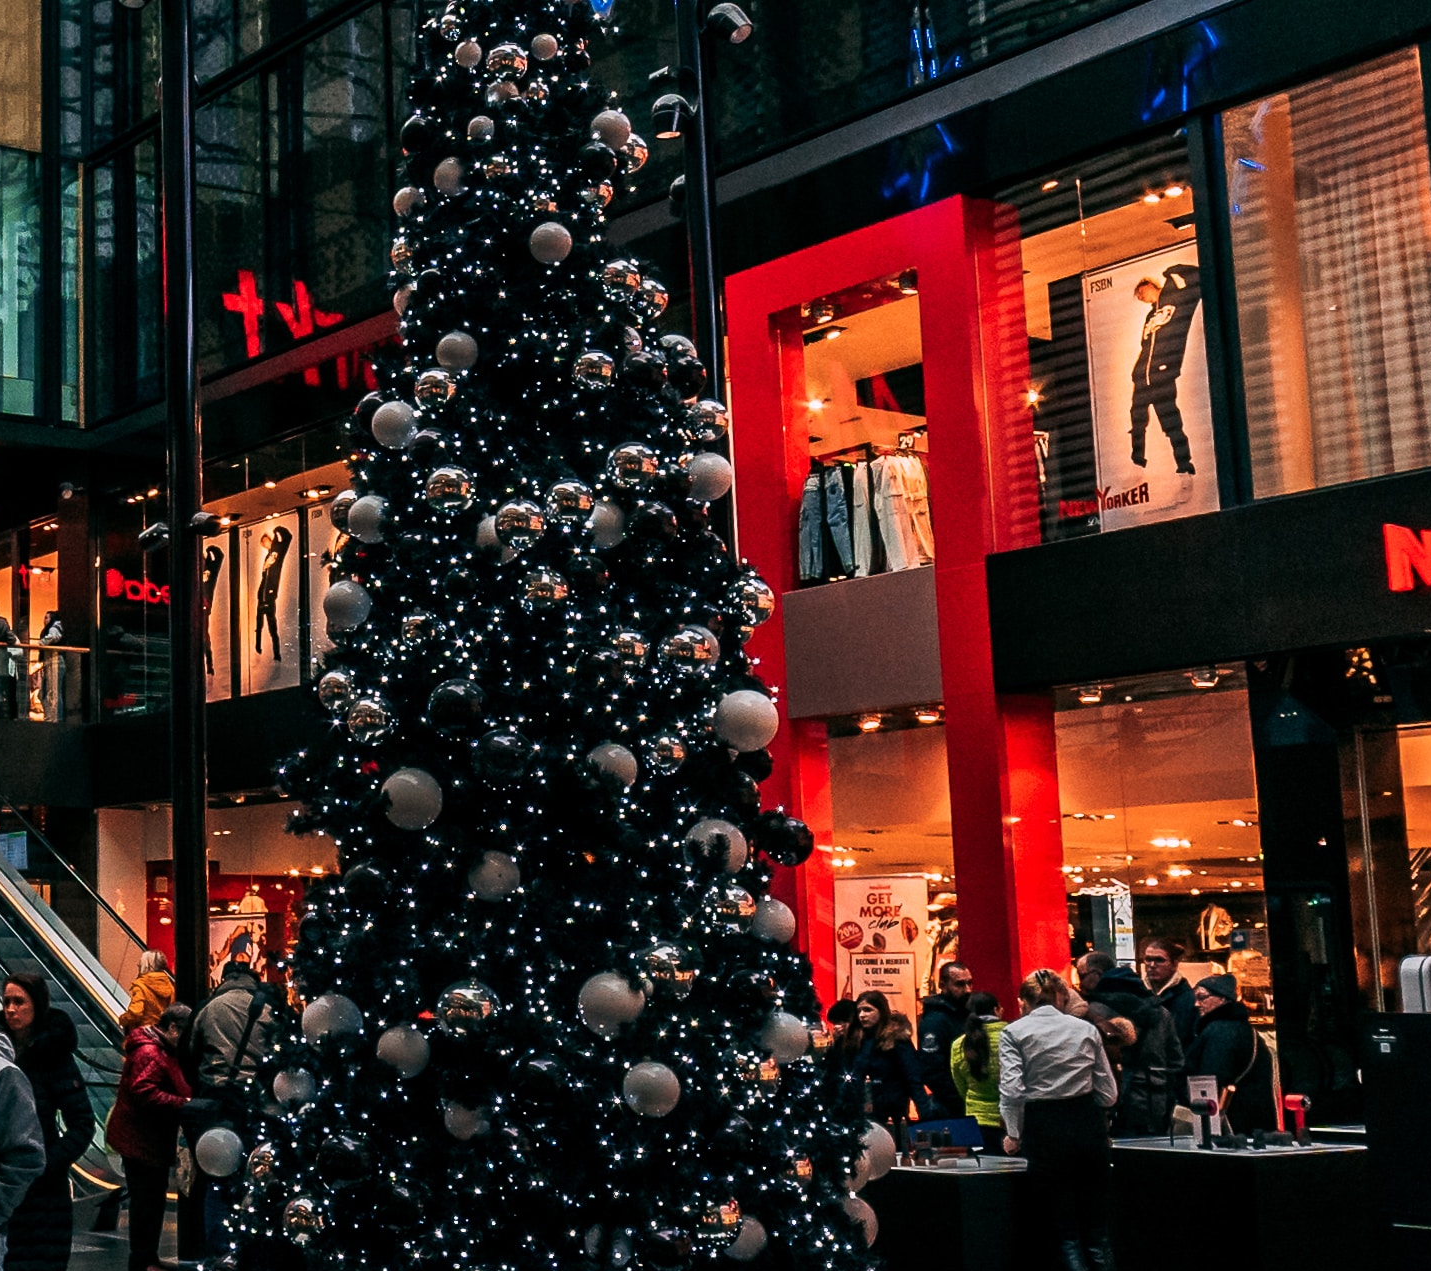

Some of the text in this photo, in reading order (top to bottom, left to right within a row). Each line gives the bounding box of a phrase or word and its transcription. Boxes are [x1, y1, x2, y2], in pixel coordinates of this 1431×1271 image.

[1090, 276, 1113, 294] FSBN
[866, 892, 892, 904] GET
[859, 905, 902, 918] MORE
